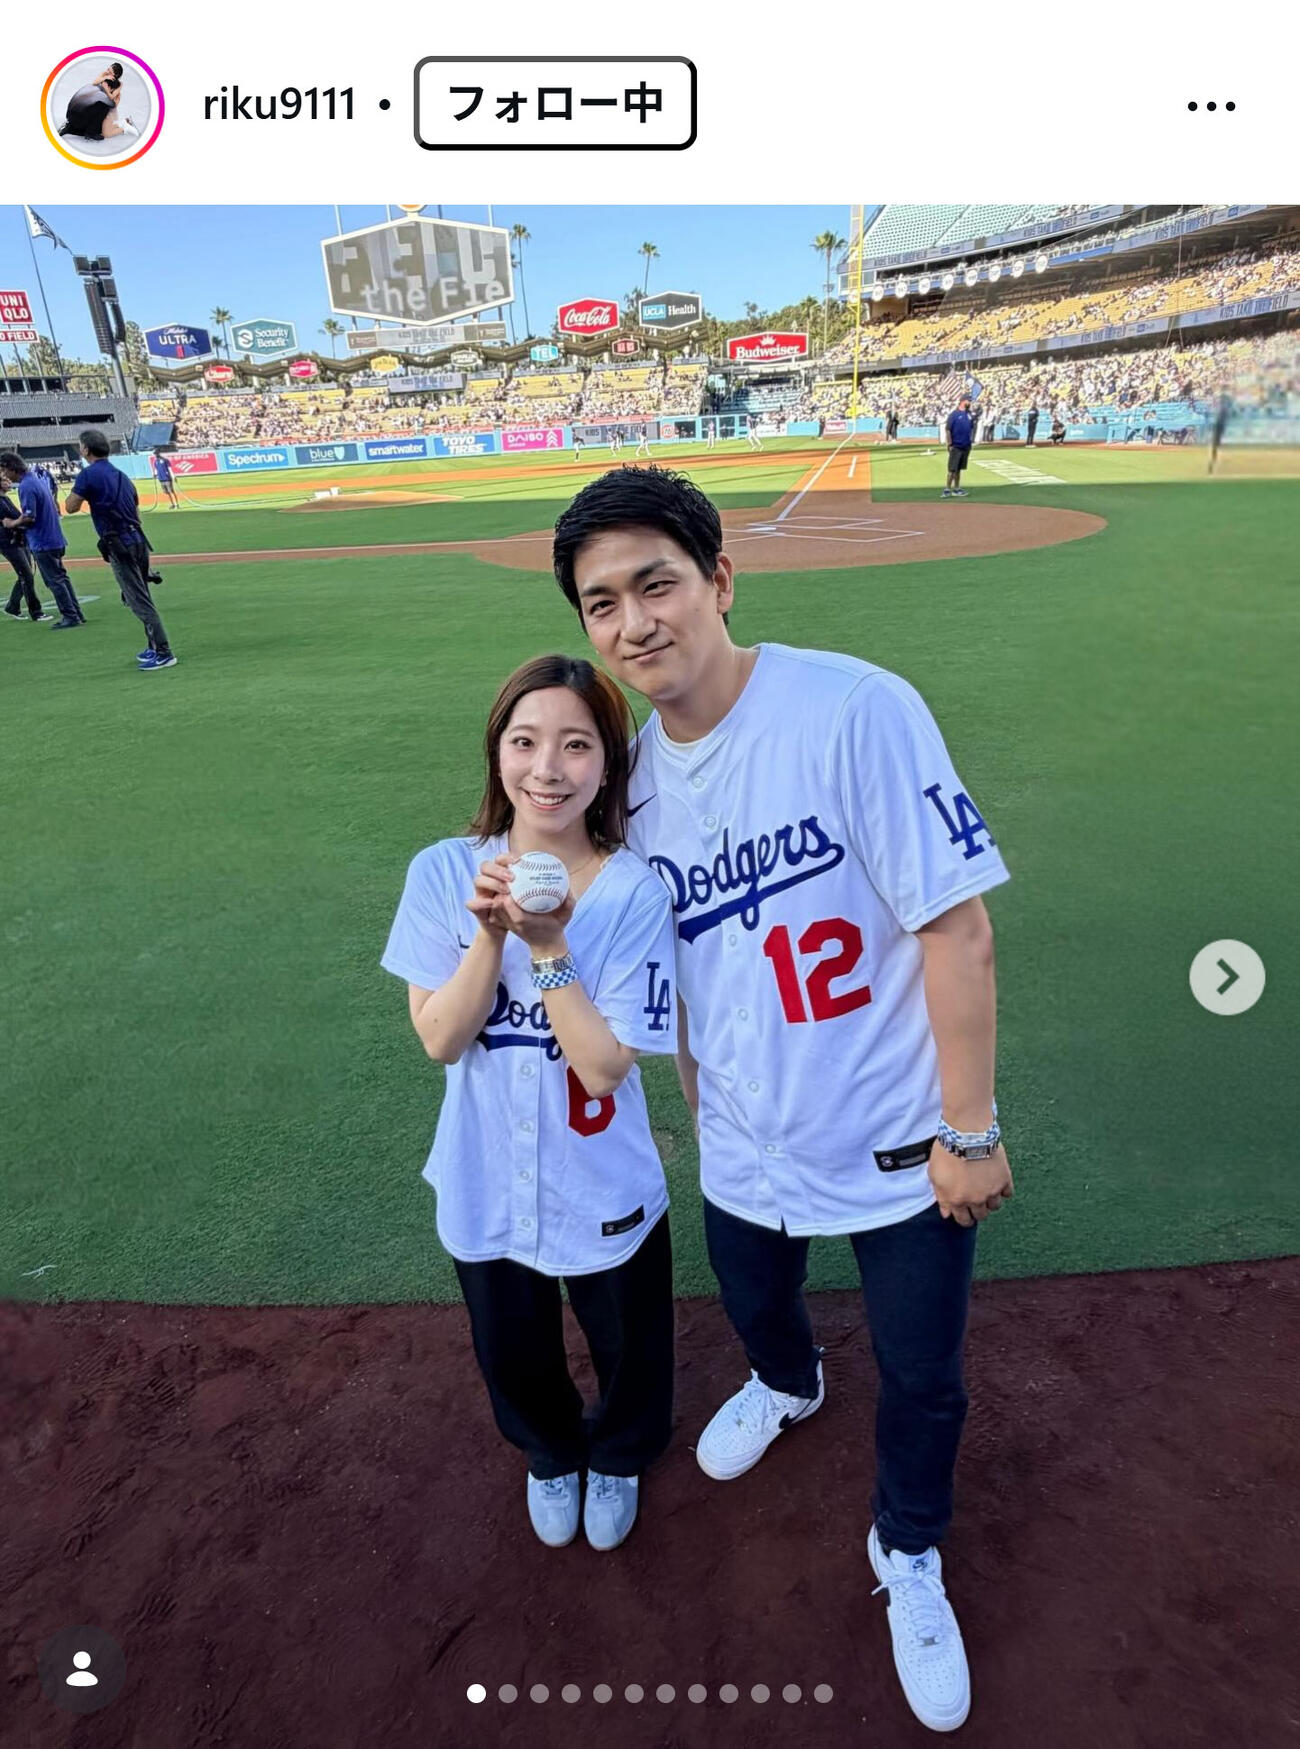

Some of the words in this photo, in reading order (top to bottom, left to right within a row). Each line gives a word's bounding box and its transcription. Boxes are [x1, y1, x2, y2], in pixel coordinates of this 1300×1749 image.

[0, 294, 24, 307] UNI
[361, 279, 427, 313] the
[4, 307, 29, 321] QLO
[668, 303, 697, 316] Health
[7, 331, 35, 341] FIELD
[158, 334, 198, 345] ULTRA
[254, 327, 289, 339] Security
[256, 337, 288, 348] Benefit
[736, 343, 800, 359] Budweiser
[442, 435, 476, 447] TOYO
[309, 447, 334, 459] blue
[368, 443, 424, 457] smartwater
[227, 452, 280, 467] Spectrum
[922, 783, 997, 861] LA
[648, 815, 845, 932] Dodgers
[762, 917, 873, 1025] 12
[643, 961, 671, 1032] LA
